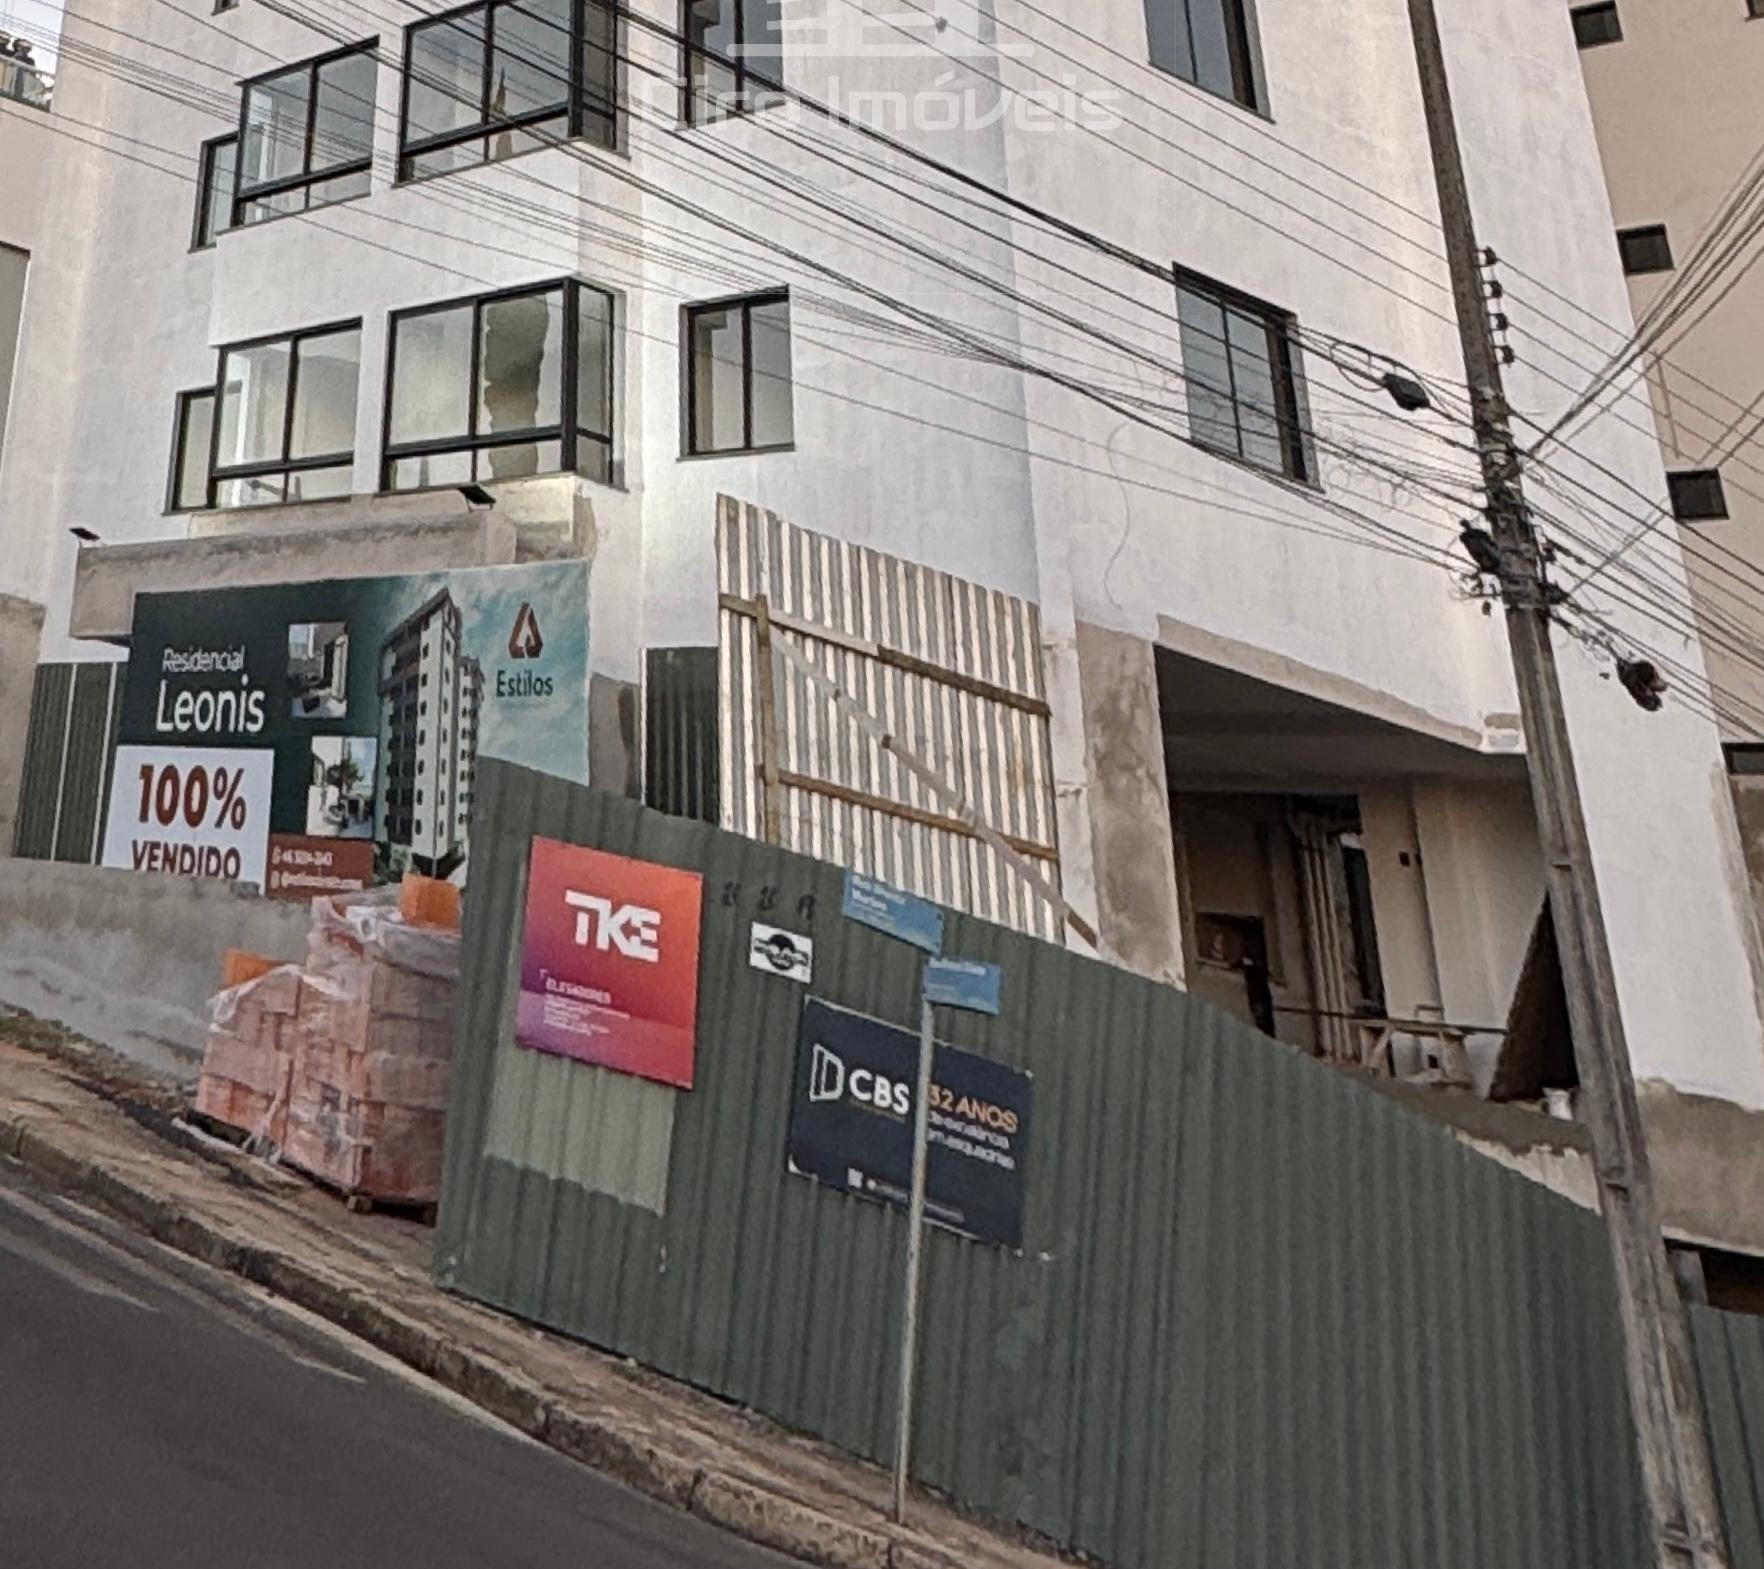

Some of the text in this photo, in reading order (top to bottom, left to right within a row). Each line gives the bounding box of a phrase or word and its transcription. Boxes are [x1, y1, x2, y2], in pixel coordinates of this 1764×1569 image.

[162, 643, 246, 673] Residencial
[156, 673, 265, 732] Leonis
[496, 669, 553, 697] Estilos
[139, 763, 247, 830] 100%
[132, 839, 241, 879] VENDIDO
[565, 889, 661, 963] TKE
[850, 1068, 910, 1115] CBS
[955, 1095, 1018, 1133] ANOS
